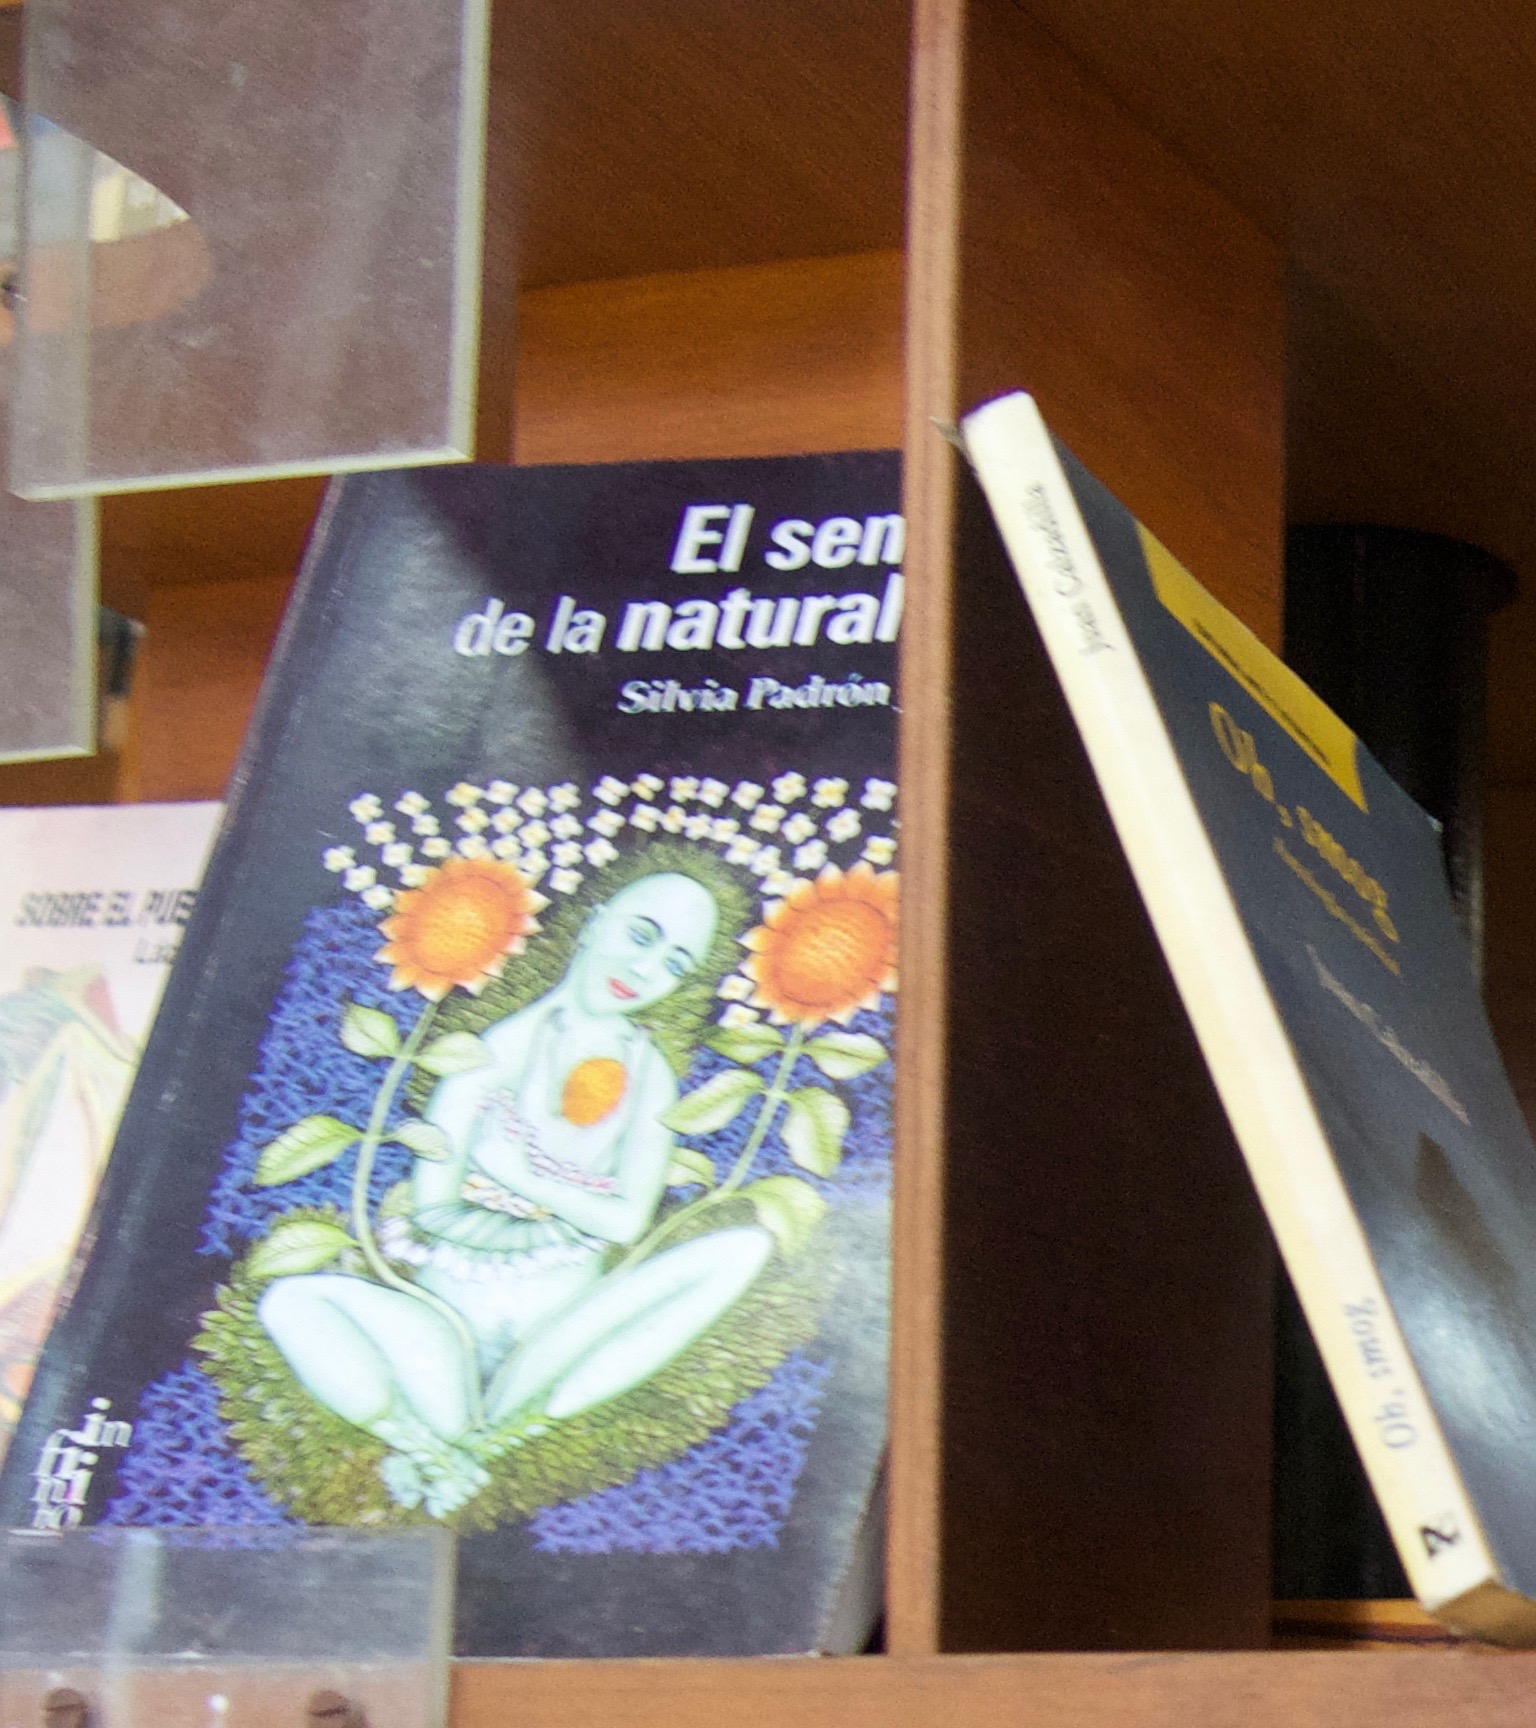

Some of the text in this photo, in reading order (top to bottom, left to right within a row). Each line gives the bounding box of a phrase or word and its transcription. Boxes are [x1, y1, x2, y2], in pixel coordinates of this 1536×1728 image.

[668, 503, 906, 575] El sen
[453, 572, 906, 657] de la natural
[617, 673, 891, 715] Silvia Padrón
